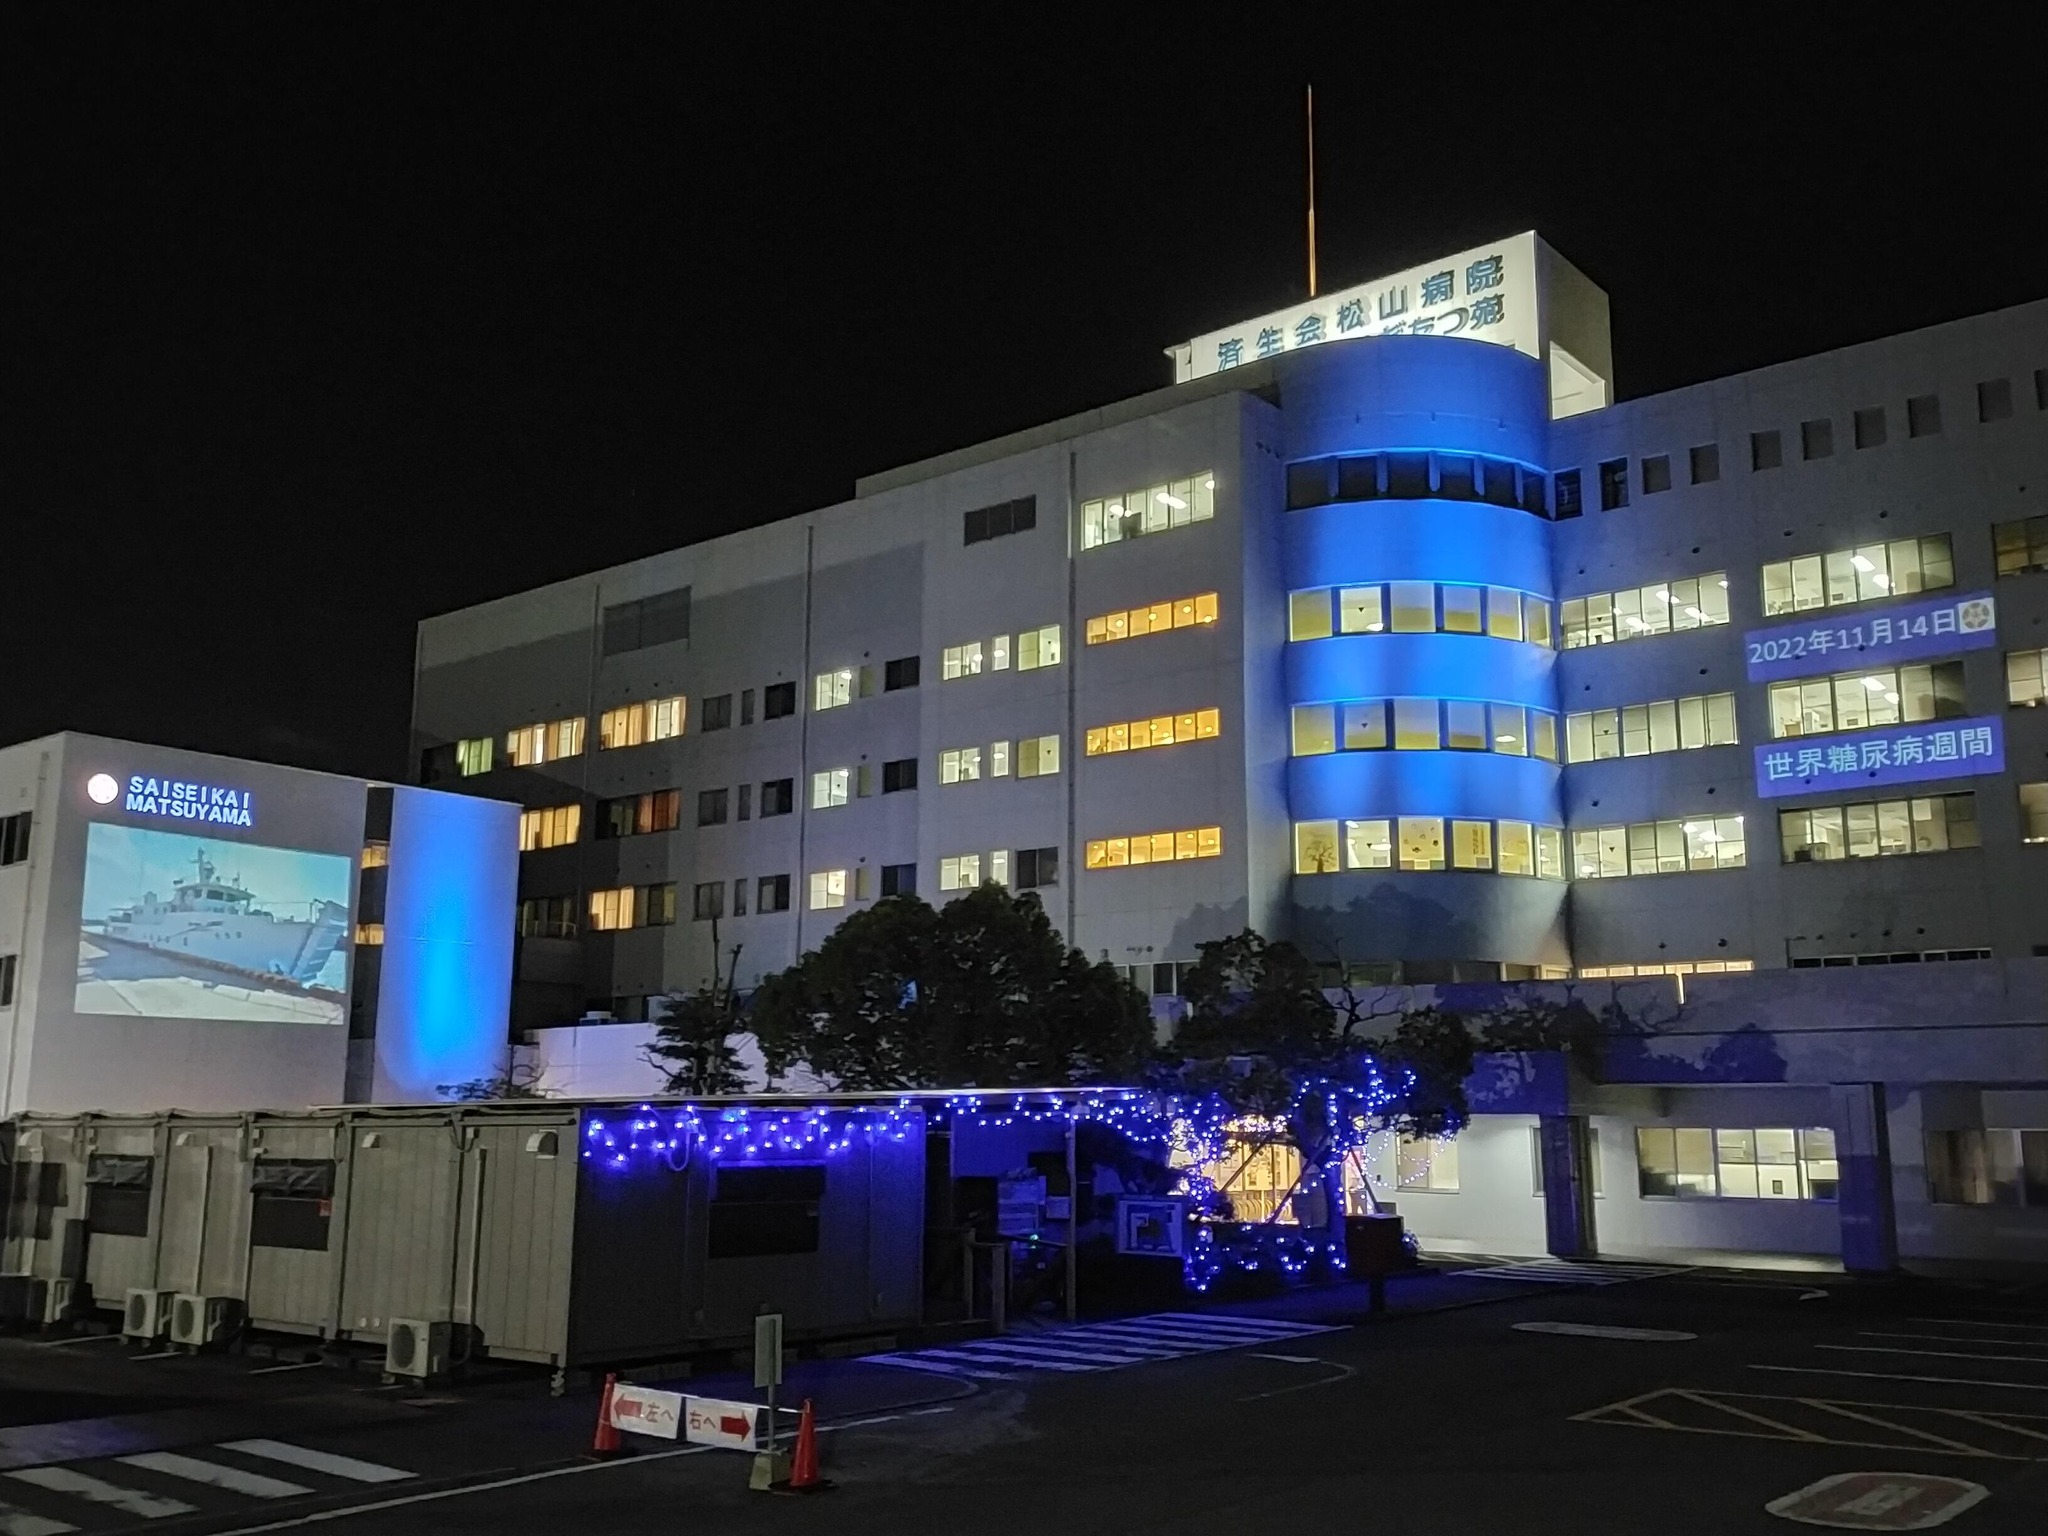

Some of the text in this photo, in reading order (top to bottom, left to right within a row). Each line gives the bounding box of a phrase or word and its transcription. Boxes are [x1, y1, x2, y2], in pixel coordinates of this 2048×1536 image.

[1218, 255, 1503, 371] 済生会松山病院
[1750, 609, 1955, 664] 2022年11月14日
[1764, 727, 1992, 780] 世界糖尿病週間
[130, 776, 249, 808] SAISEIKAI
[126, 794, 251, 826] MATSUYAMA
[645, 1403, 674, 1423] 左へ
[689, 1410, 716, 1430] 右へ
